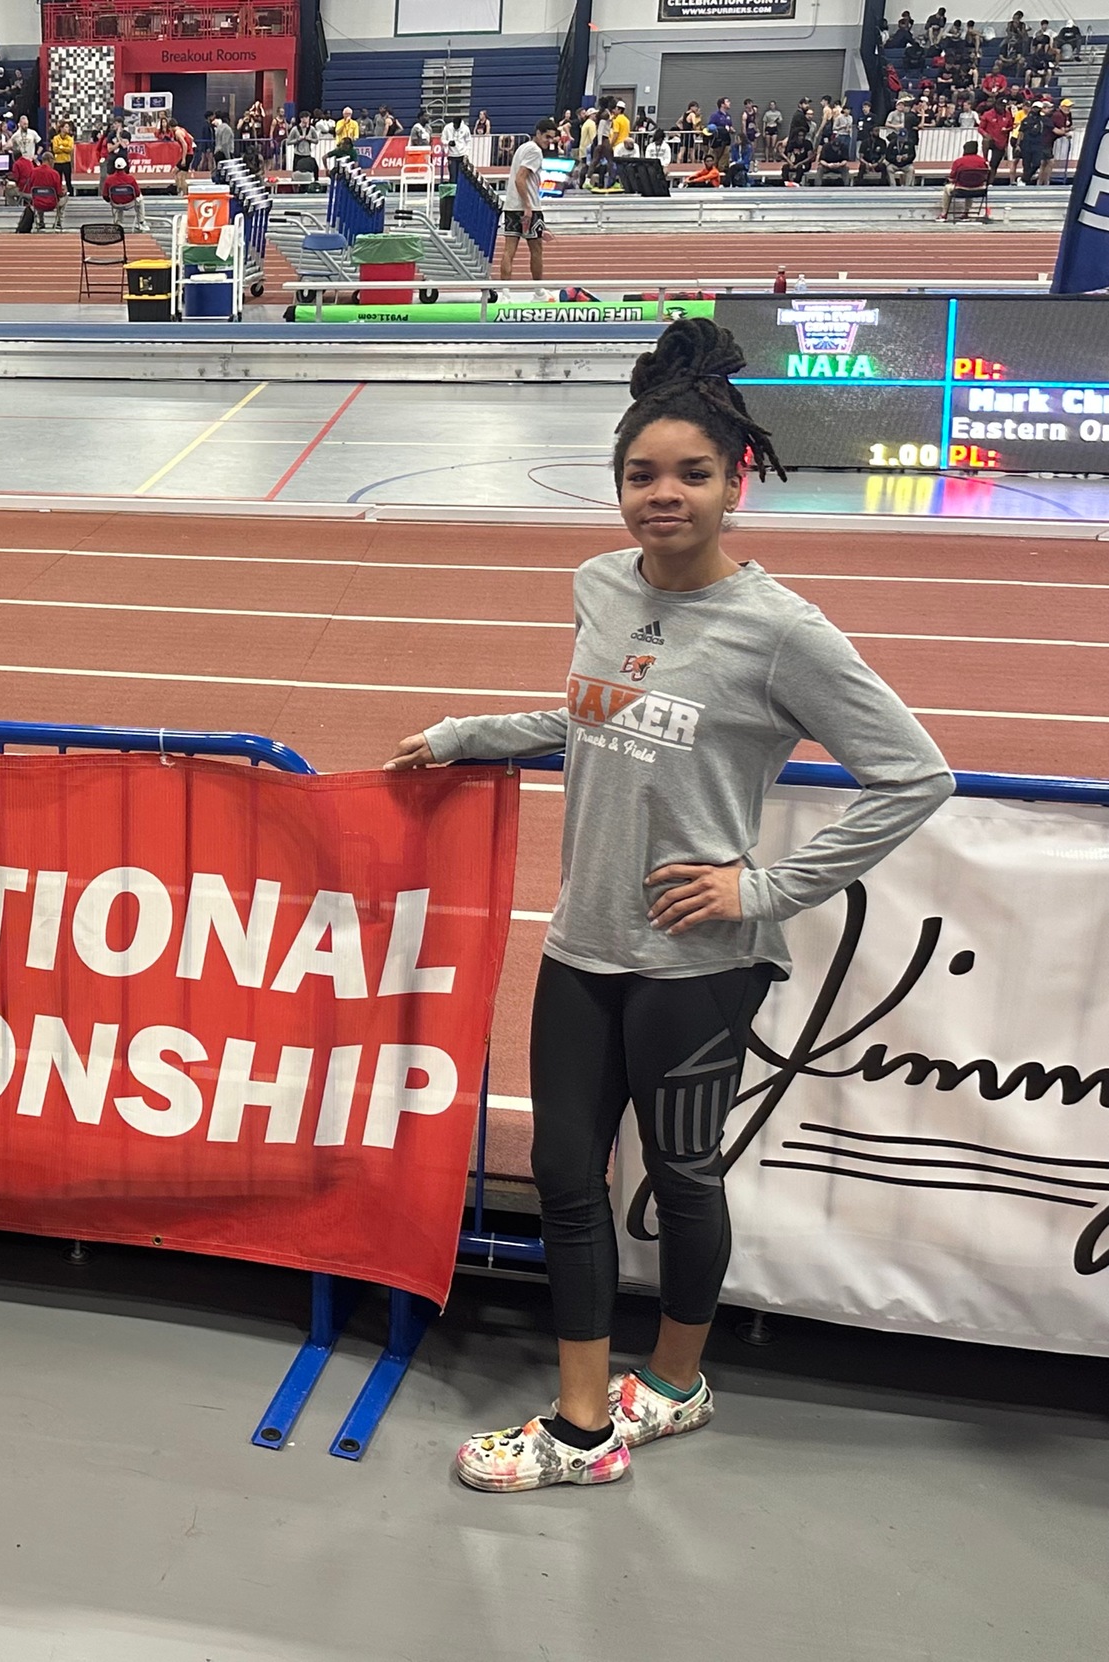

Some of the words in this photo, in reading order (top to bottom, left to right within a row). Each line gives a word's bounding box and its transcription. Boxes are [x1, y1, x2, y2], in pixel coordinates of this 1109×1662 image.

[161, 49, 212, 63] Breakout
[216, 49, 257, 61] Rooms
[200, 202, 213, 217] G
[495, 308, 600, 322] UNIVERSITY
[604, 307, 642, 321] LIFE
[787, 355, 873, 377] NAIA
[954, 358, 1001, 380] PL:
[968, 388, 1052, 412] Mark
[952, 416, 1067, 440] Eastern
[869, 443, 938, 466] 1.00
[948, 445, 996, 467] PL:
[630, 631, 665, 646] adidas
[568, 677, 699, 744] BAKER
[576, 727, 606, 748] Track
[608, 737, 619, 751] &
[623, 740, 656, 763] Field
